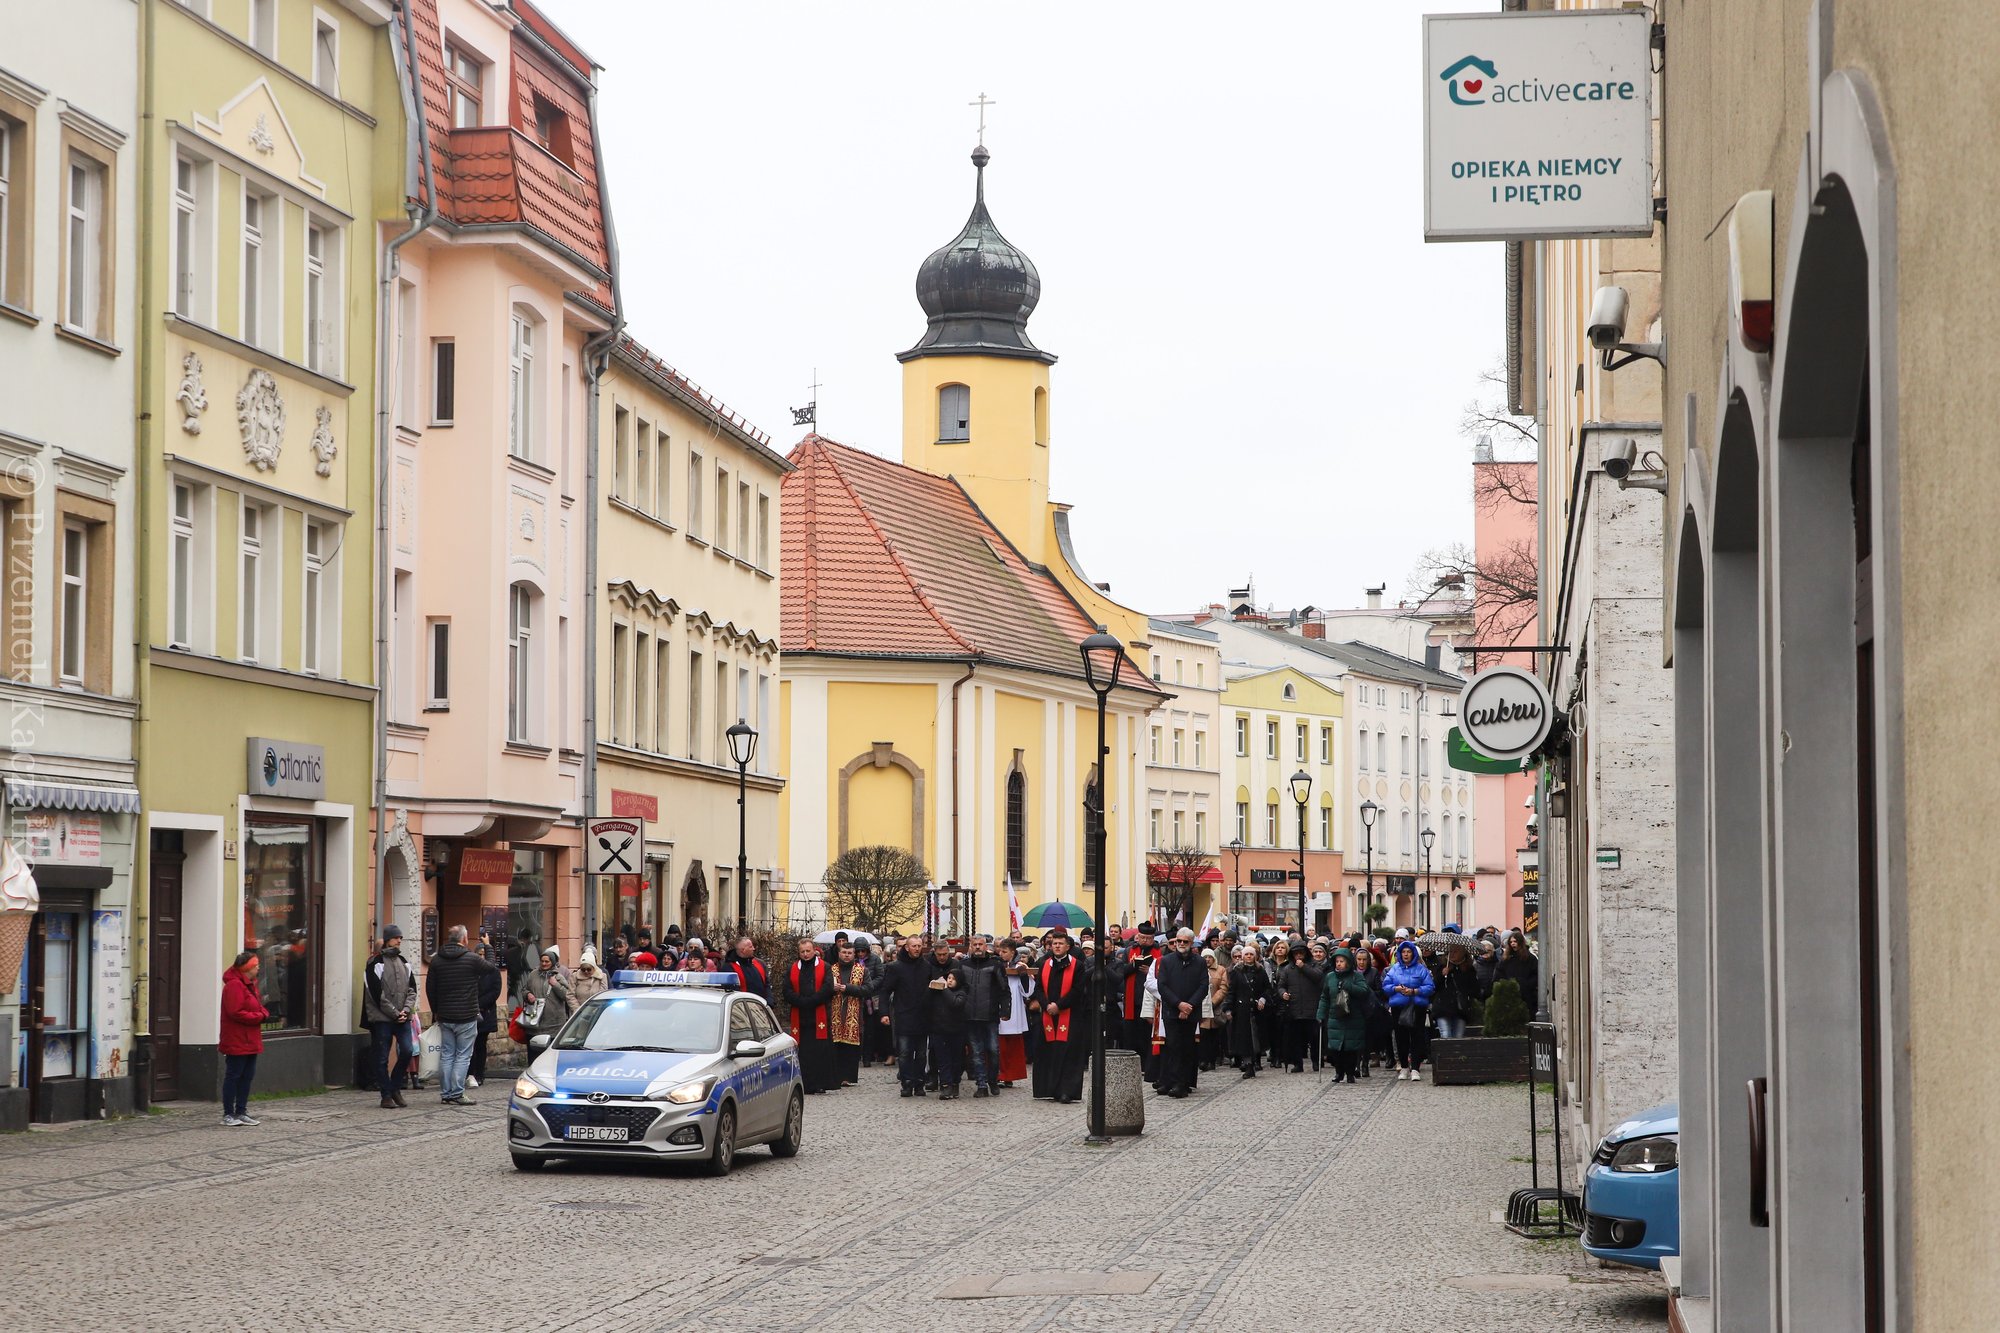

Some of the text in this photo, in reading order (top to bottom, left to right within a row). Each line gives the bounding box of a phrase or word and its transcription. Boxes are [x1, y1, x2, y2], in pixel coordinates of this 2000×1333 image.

[1491, 78, 1635, 103] activecare
[1451, 157, 1622, 179] OPIEKA NIEMCY
[1492, 184, 1582, 205] I PIĘTRO
[1469, 698, 1541, 727] cukru
[279, 752, 321, 783] atlantic
[595, 823, 635, 833] Pierogarnia
[464, 854, 513, 879] Pierogarnia
[1257, 871, 1281, 879] OPTYK
[645, 972, 685, 983] POLICJA
[562, 1067, 649, 1080] POLICJA
[741, 1070, 764, 1098] POLICJA
[571, 1127, 595, 1139] HPB
[599, 1128, 627, 1140] C759
